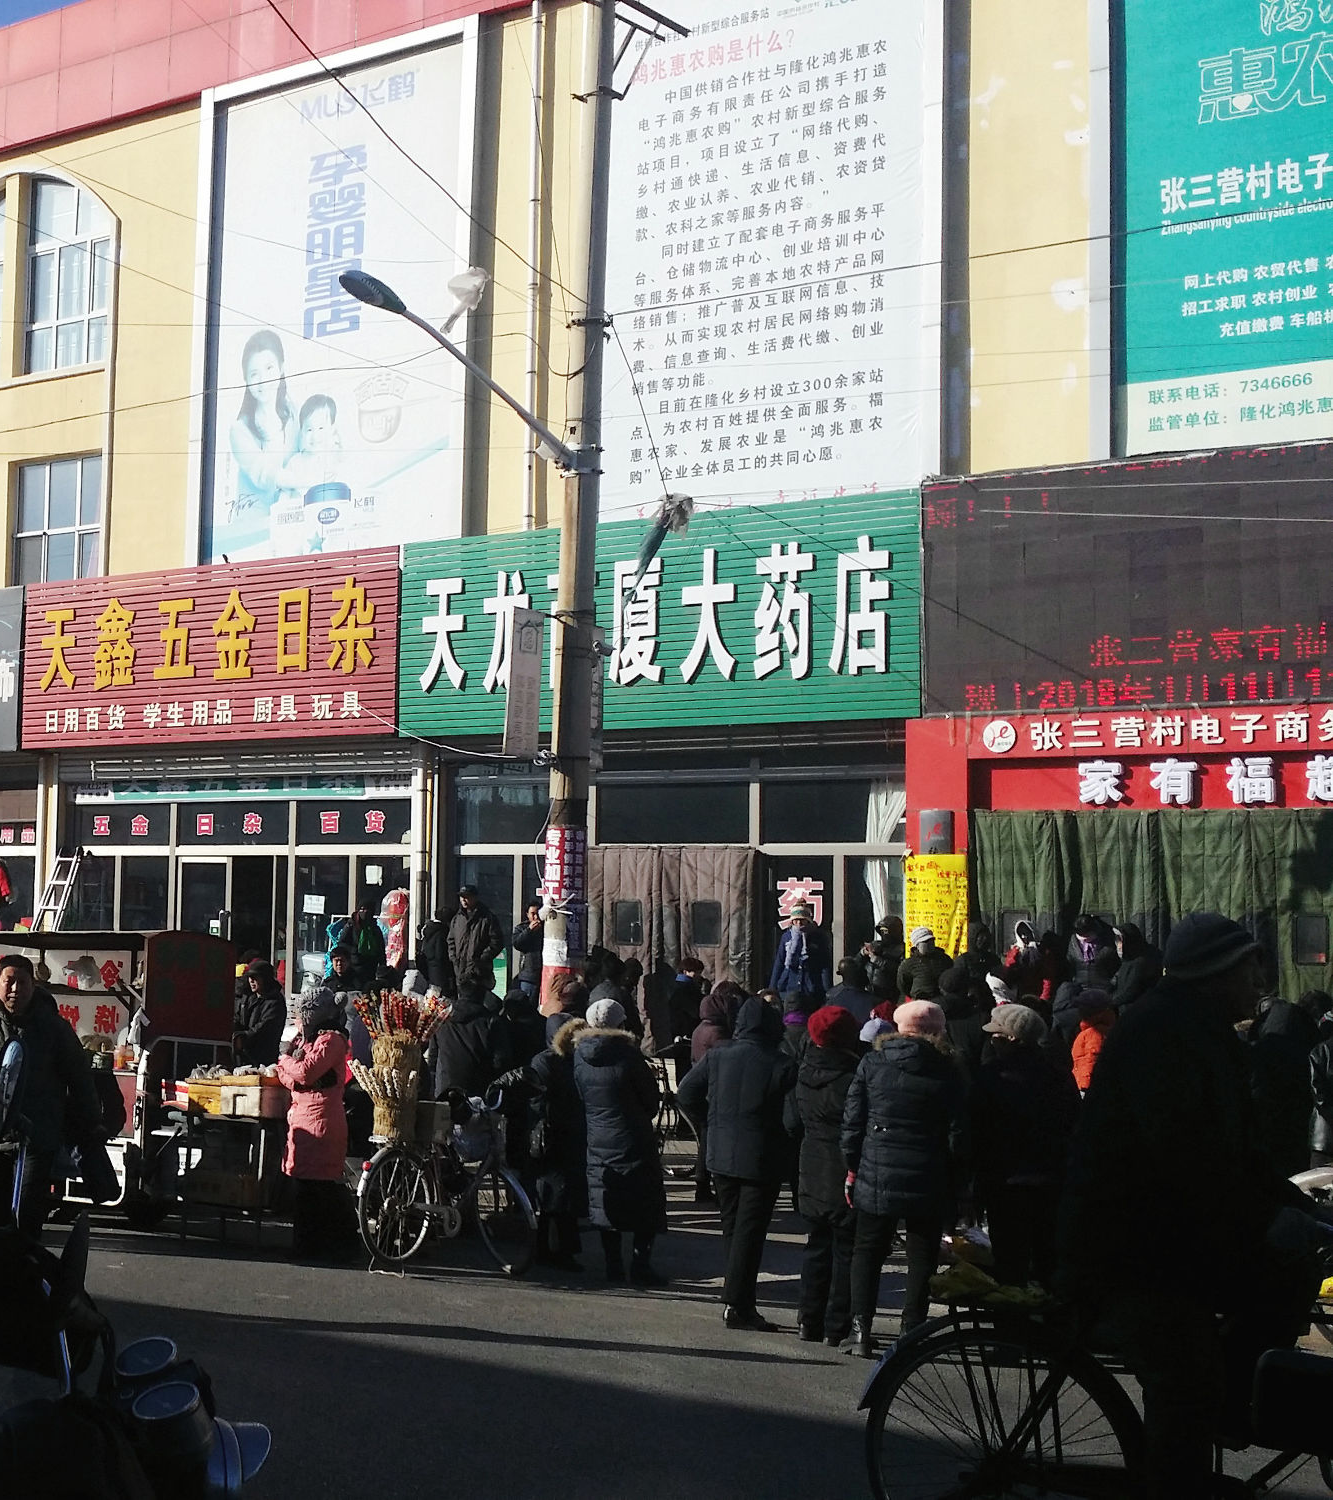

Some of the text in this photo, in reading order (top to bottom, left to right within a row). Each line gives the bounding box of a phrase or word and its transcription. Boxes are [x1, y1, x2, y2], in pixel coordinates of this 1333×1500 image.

[635, 8, 769, 52] 供销合作社村新型综合服务站
[638, 62, 887, 131] 电子商务有限责任公司携手打造
[665, 40, 887, 104] 中国供销合作社与隆化鸿兆惠农
[635, 155, 886, 220] 缴、农业认养、农业代销、农资贷
[637, 133, 886, 198] 乡村通快递、生活信息、资费代
[1160, 153, 1333, 215] 张三营村电子
[661, 203, 885, 259] 同时建立了配套电子商务服务平
[1161, 213, 1232, 236] Zhangsanying
[1234, 202, 1295, 224] countryside
[634, 249, 884, 308] 等服务体系、完善本地农特产品网
[635, 227, 885, 286] 台、仓储物流中心、创业培训中心
[1184, 268, 1248, 290] 网上代购
[1253, 257, 1319, 280] 农贸代售
[633, 273, 884, 330] 络销售；推广普及互联网信息、技
[633, 297, 884, 352] 术。从而实现农村居民网络购物消
[1181, 295, 1246, 317] 招工求职
[1252, 284, 1318, 306] 农村创业
[1219, 316, 1284, 338] 充值缴费
[633, 321, 884, 374] 费、信息查询、生活费代缴、创业
[632, 372, 714, 398] 销售等功能。
[659, 367, 883, 415] 目前在隆化乡村设立300余家站
[1240, 372, 1313, 393] 7346666
[1240, 397, 1333, 422] 隆化鸿兆惠
[40, 577, 377, 692] 天鑫五金日杂
[419, 535, 891, 693] 天龙厦大药店
[45, 691, 361, 732] 日用百货 学生用品 厨具 玩具
[1078, 755, 1333, 805] 家有福超
[93, 810, 385, 836] 五金 日杂 百货
[545, 829, 561, 900] 专业加工
[777, 877, 824, 928] 药
